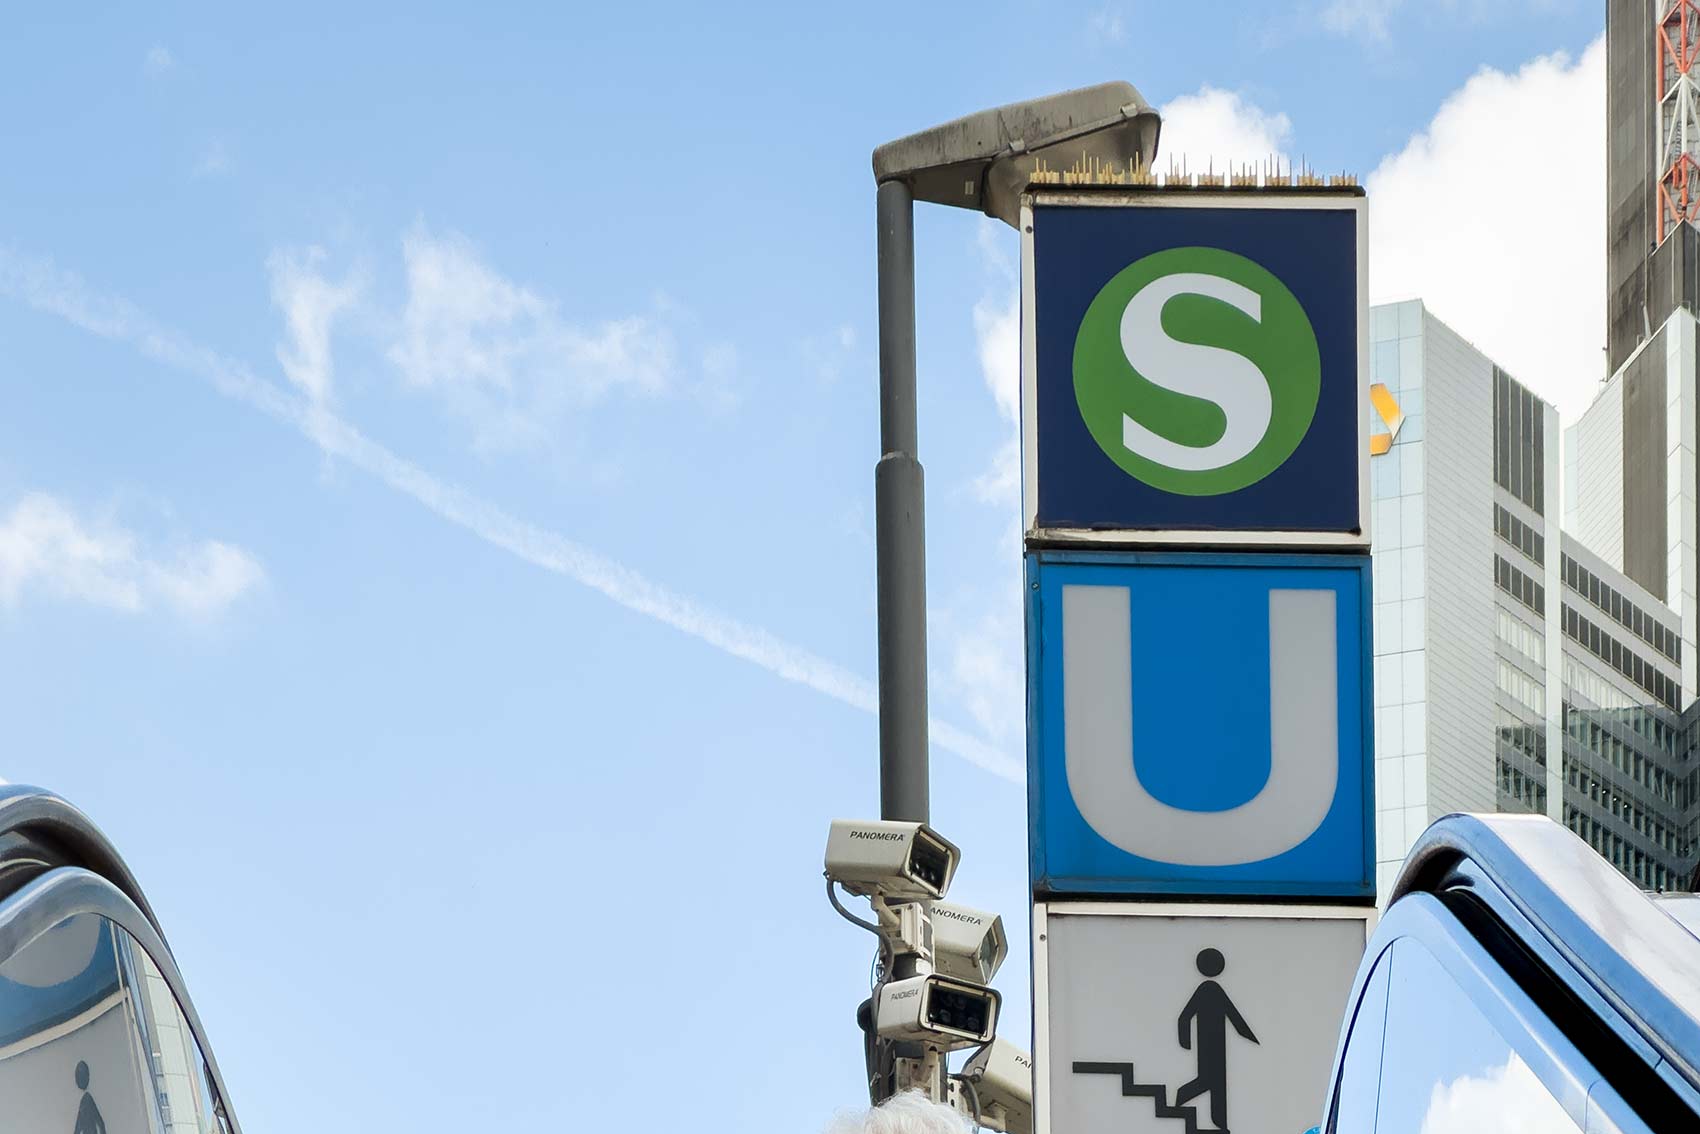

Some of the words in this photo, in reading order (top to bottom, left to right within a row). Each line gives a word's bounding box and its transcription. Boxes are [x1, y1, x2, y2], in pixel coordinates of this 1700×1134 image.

[1120, 272, 1272, 471] S
[1062, 585, 1338, 866] U
[849, 831, 904, 842] PANOMERA
[930, 907, 982, 926] ANOMERA
